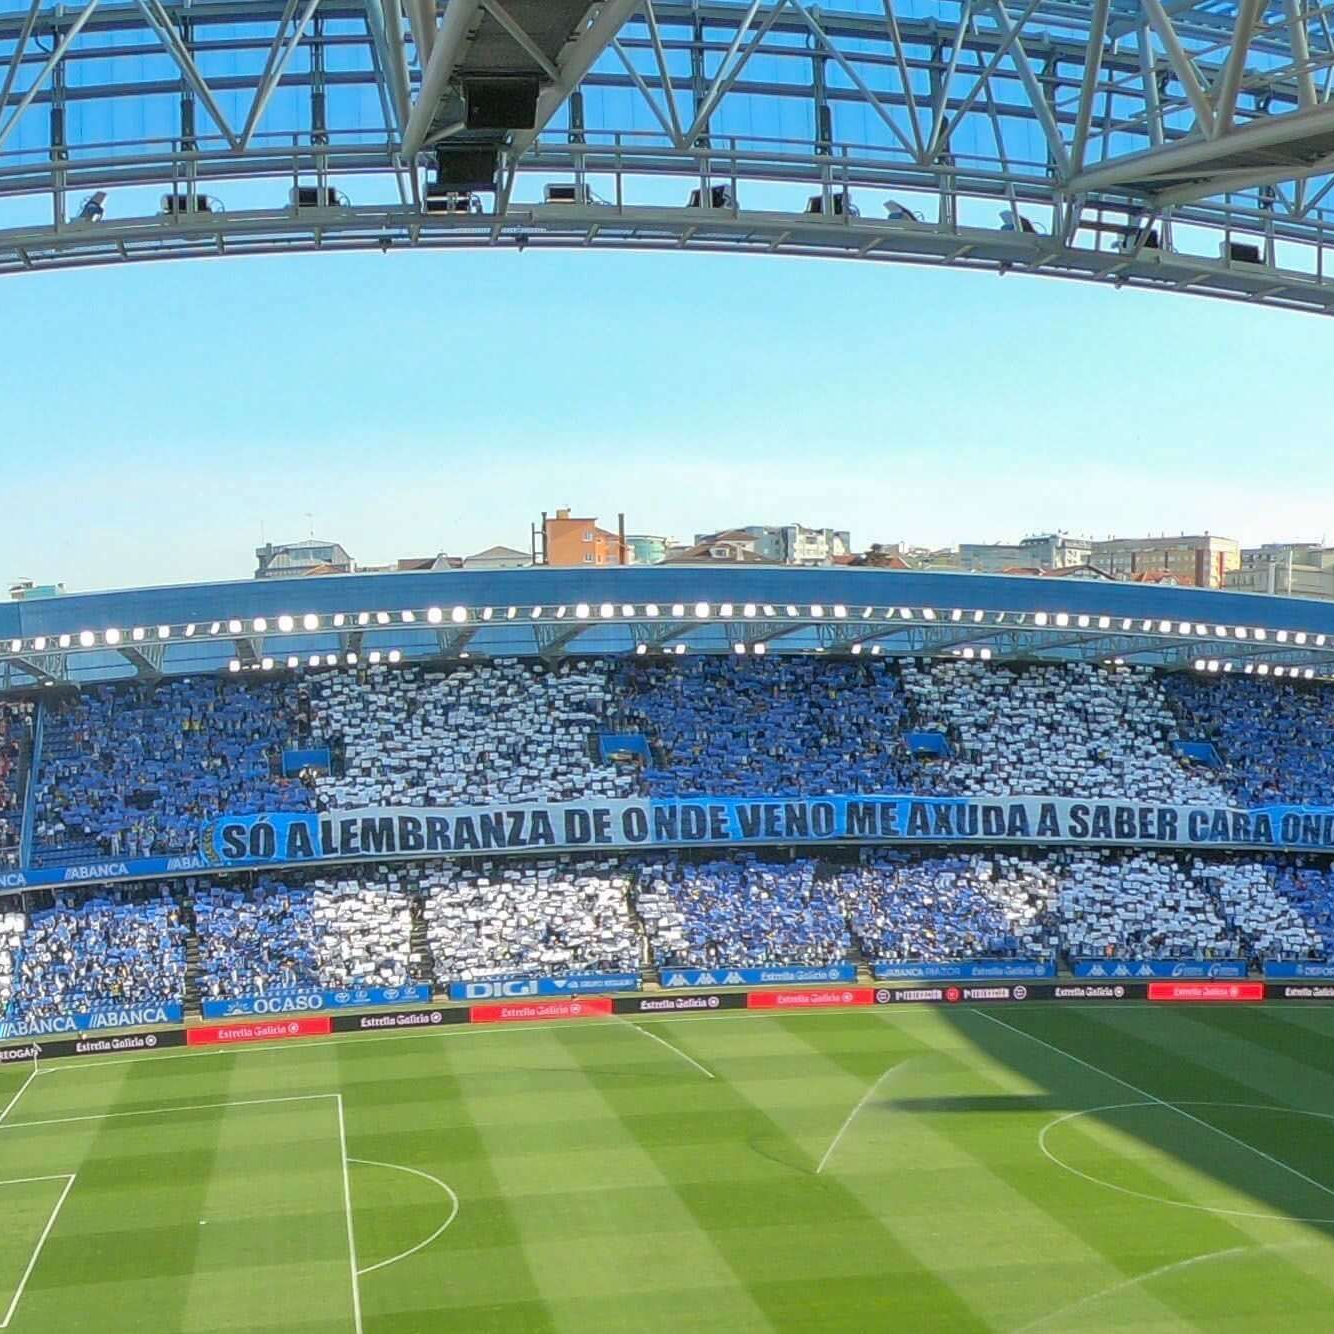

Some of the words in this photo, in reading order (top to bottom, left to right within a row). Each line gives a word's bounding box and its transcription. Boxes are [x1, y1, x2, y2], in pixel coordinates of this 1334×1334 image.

[222, 817, 269, 860] SÓ
[286, 818, 314, 857] A
[322, 808, 553, 857] LEMBRANZA
[567, 807, 612, 844] DE
[623, 804, 730, 842] ONDE
[740, 803, 834, 838] VENO
[847, 805, 897, 837] ME
[907, 804, 1026, 837] AXUDA
[1037, 805, 1060, 837] A
[1069, 805, 1179, 840] SABER
[1189, 810, 1272, 843] CARA
[70, 862, 128, 879] ABANCA
[466, 980, 538, 998] DIGI
[254, 995, 322, 1013] OCASO
[8, 1016, 76, 1036] ABANCA
[96, 1008, 167, 1027] ABANCA
